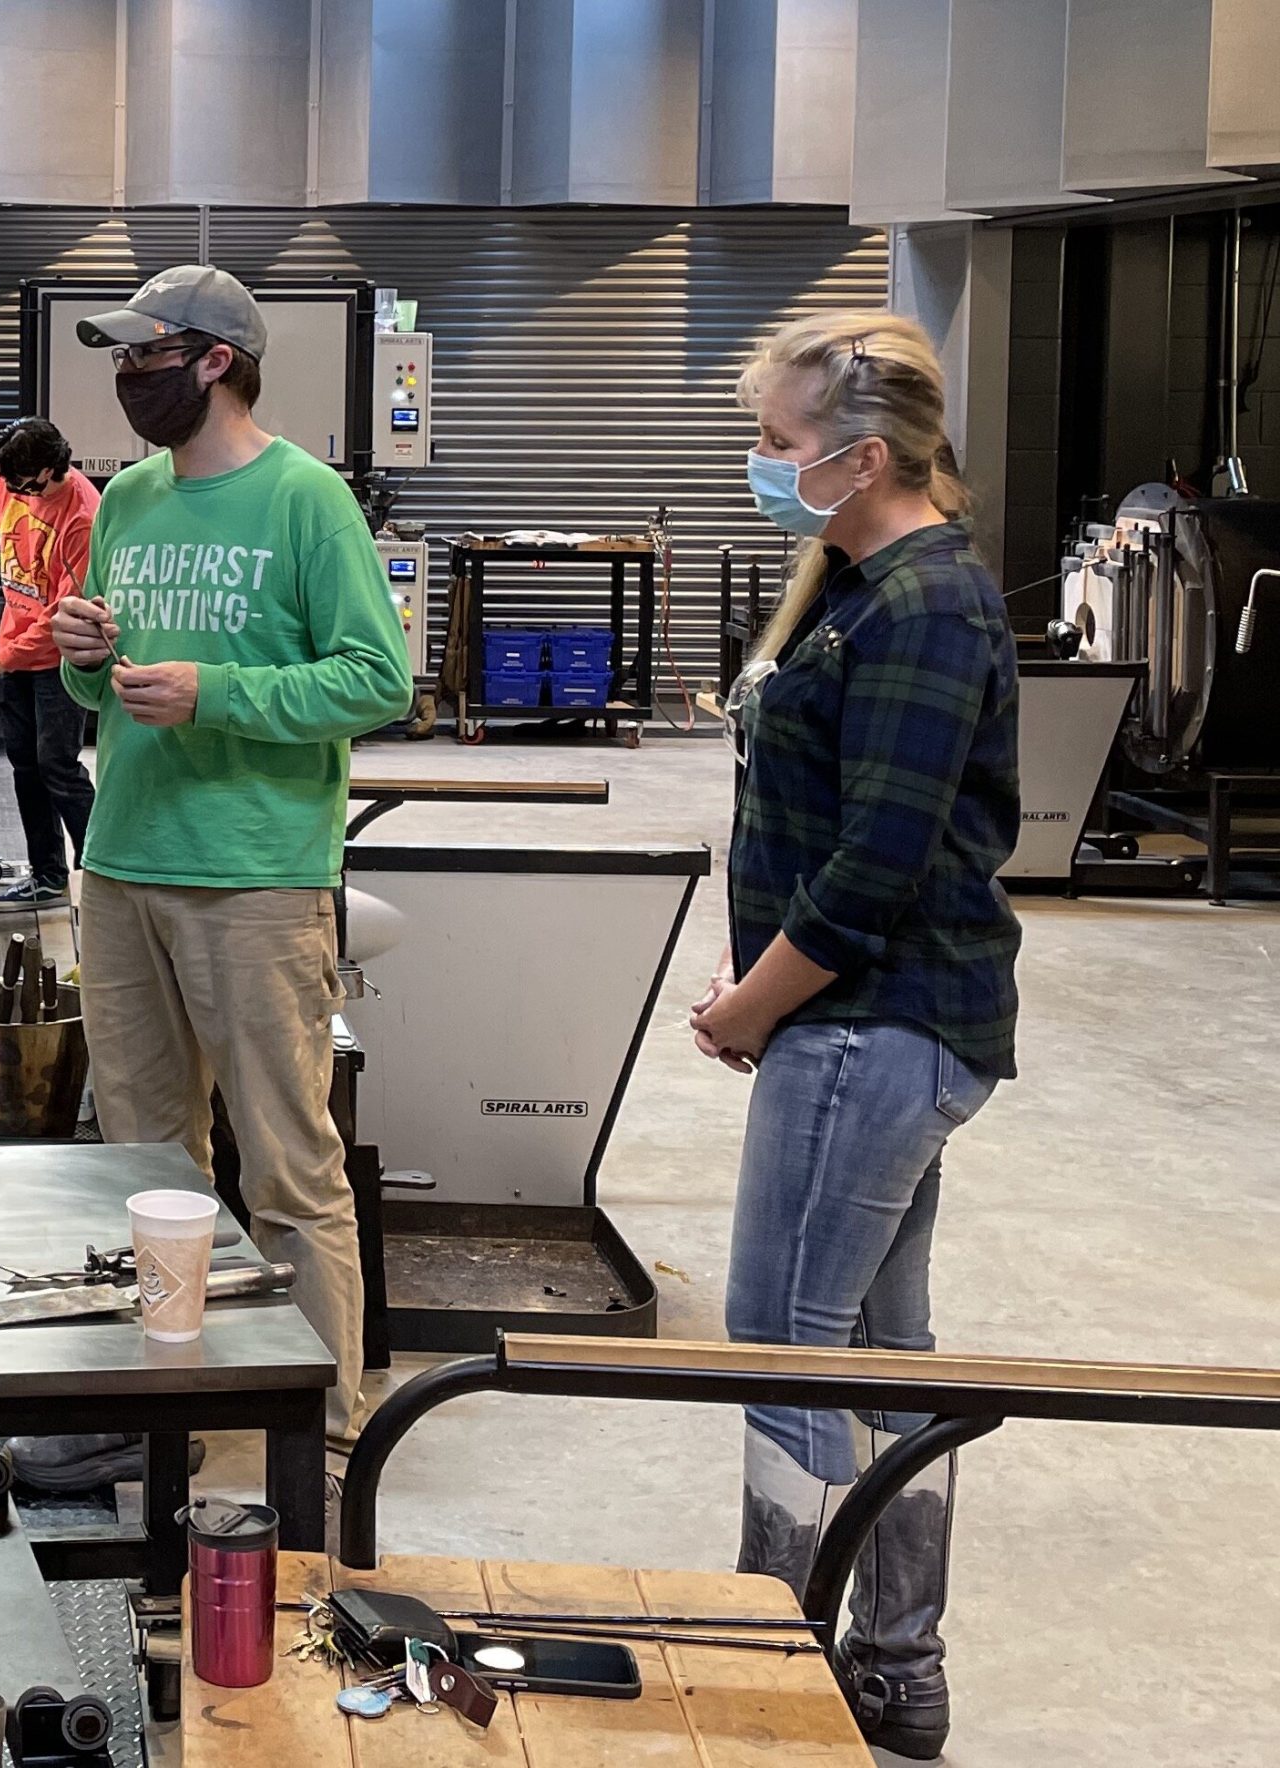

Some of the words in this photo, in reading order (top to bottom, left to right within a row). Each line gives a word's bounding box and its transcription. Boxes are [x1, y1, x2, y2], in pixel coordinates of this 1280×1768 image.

[327, 434, 336, 458] 1
[84, 458, 96, 471] IN
[98, 458, 118, 472] USE
[108, 543, 274, 590] HEADFIRST
[1043, 812, 1067, 820] ARTS
[485, 1102, 540, 1113] SPIRAL
[543, 1103, 584, 1114] ARTS
